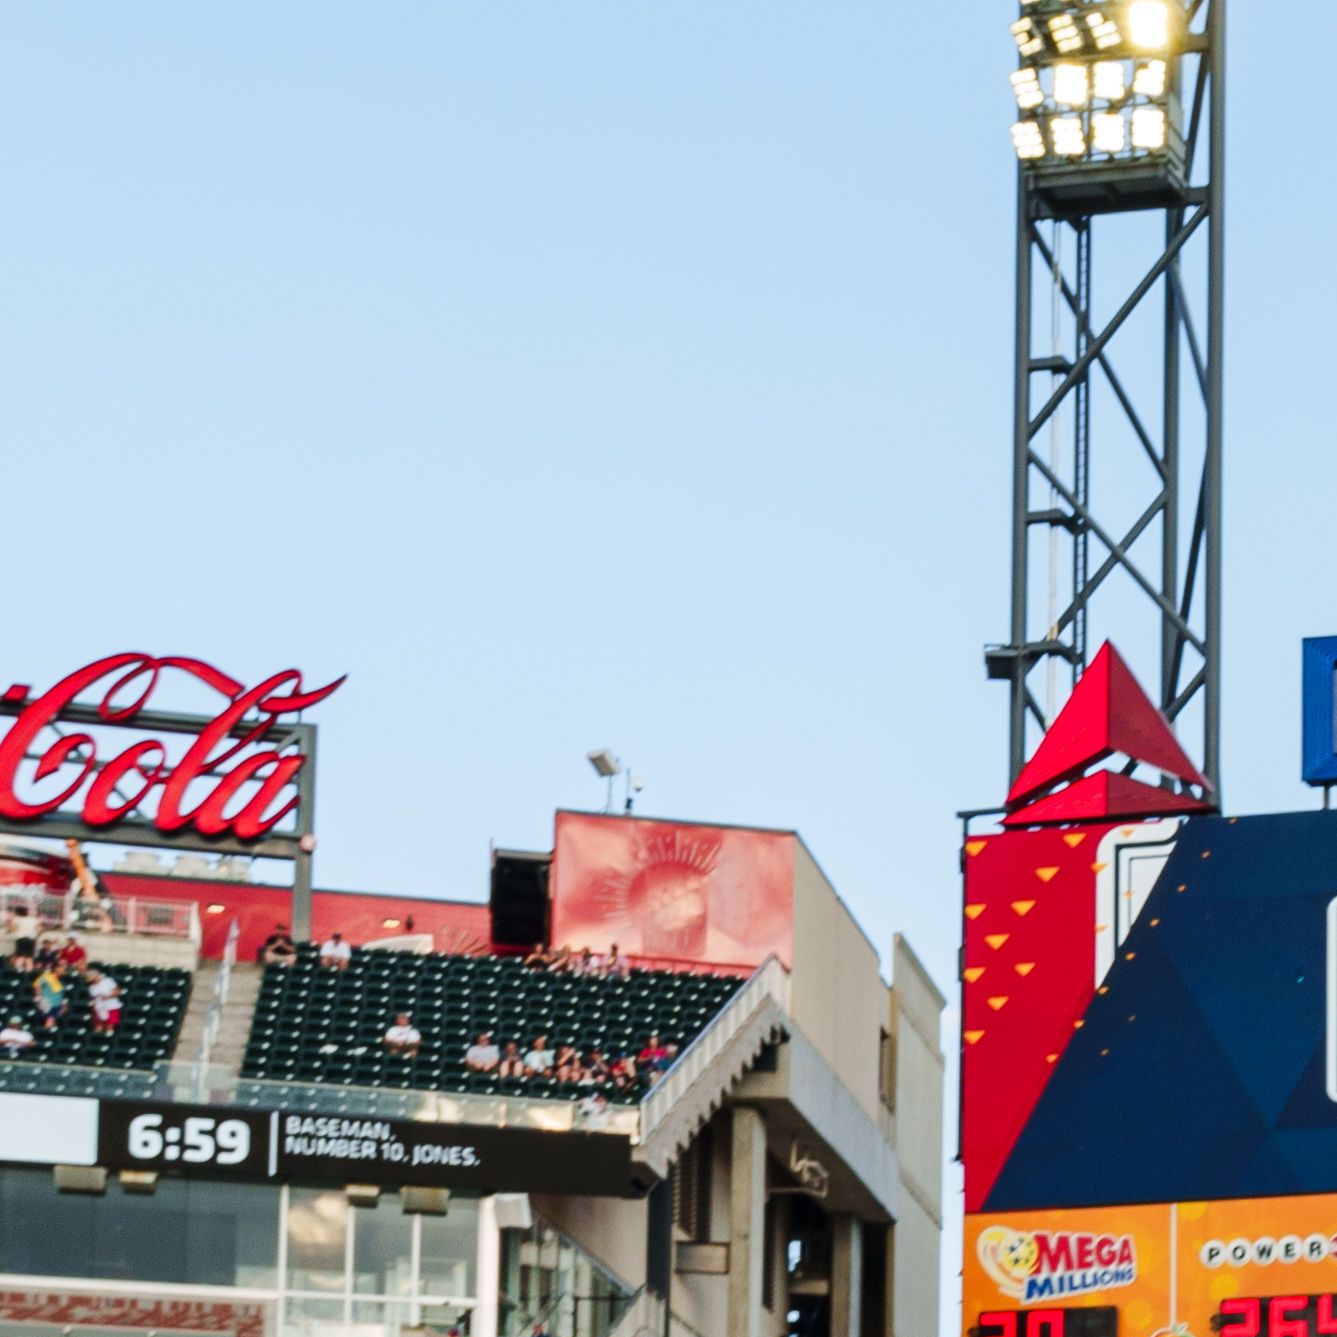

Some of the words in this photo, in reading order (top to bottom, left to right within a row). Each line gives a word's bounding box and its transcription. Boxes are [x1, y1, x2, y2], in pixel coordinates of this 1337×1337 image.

[128, 1113, 251, 1165] 6:59
[285, 1115, 396, 1140] BASEMAN,
[285, 1135, 376, 1160] NUMBER
[1032, 1233, 1134, 1274] MEGA
[1024, 1266, 1134, 1300] MILLIONS
